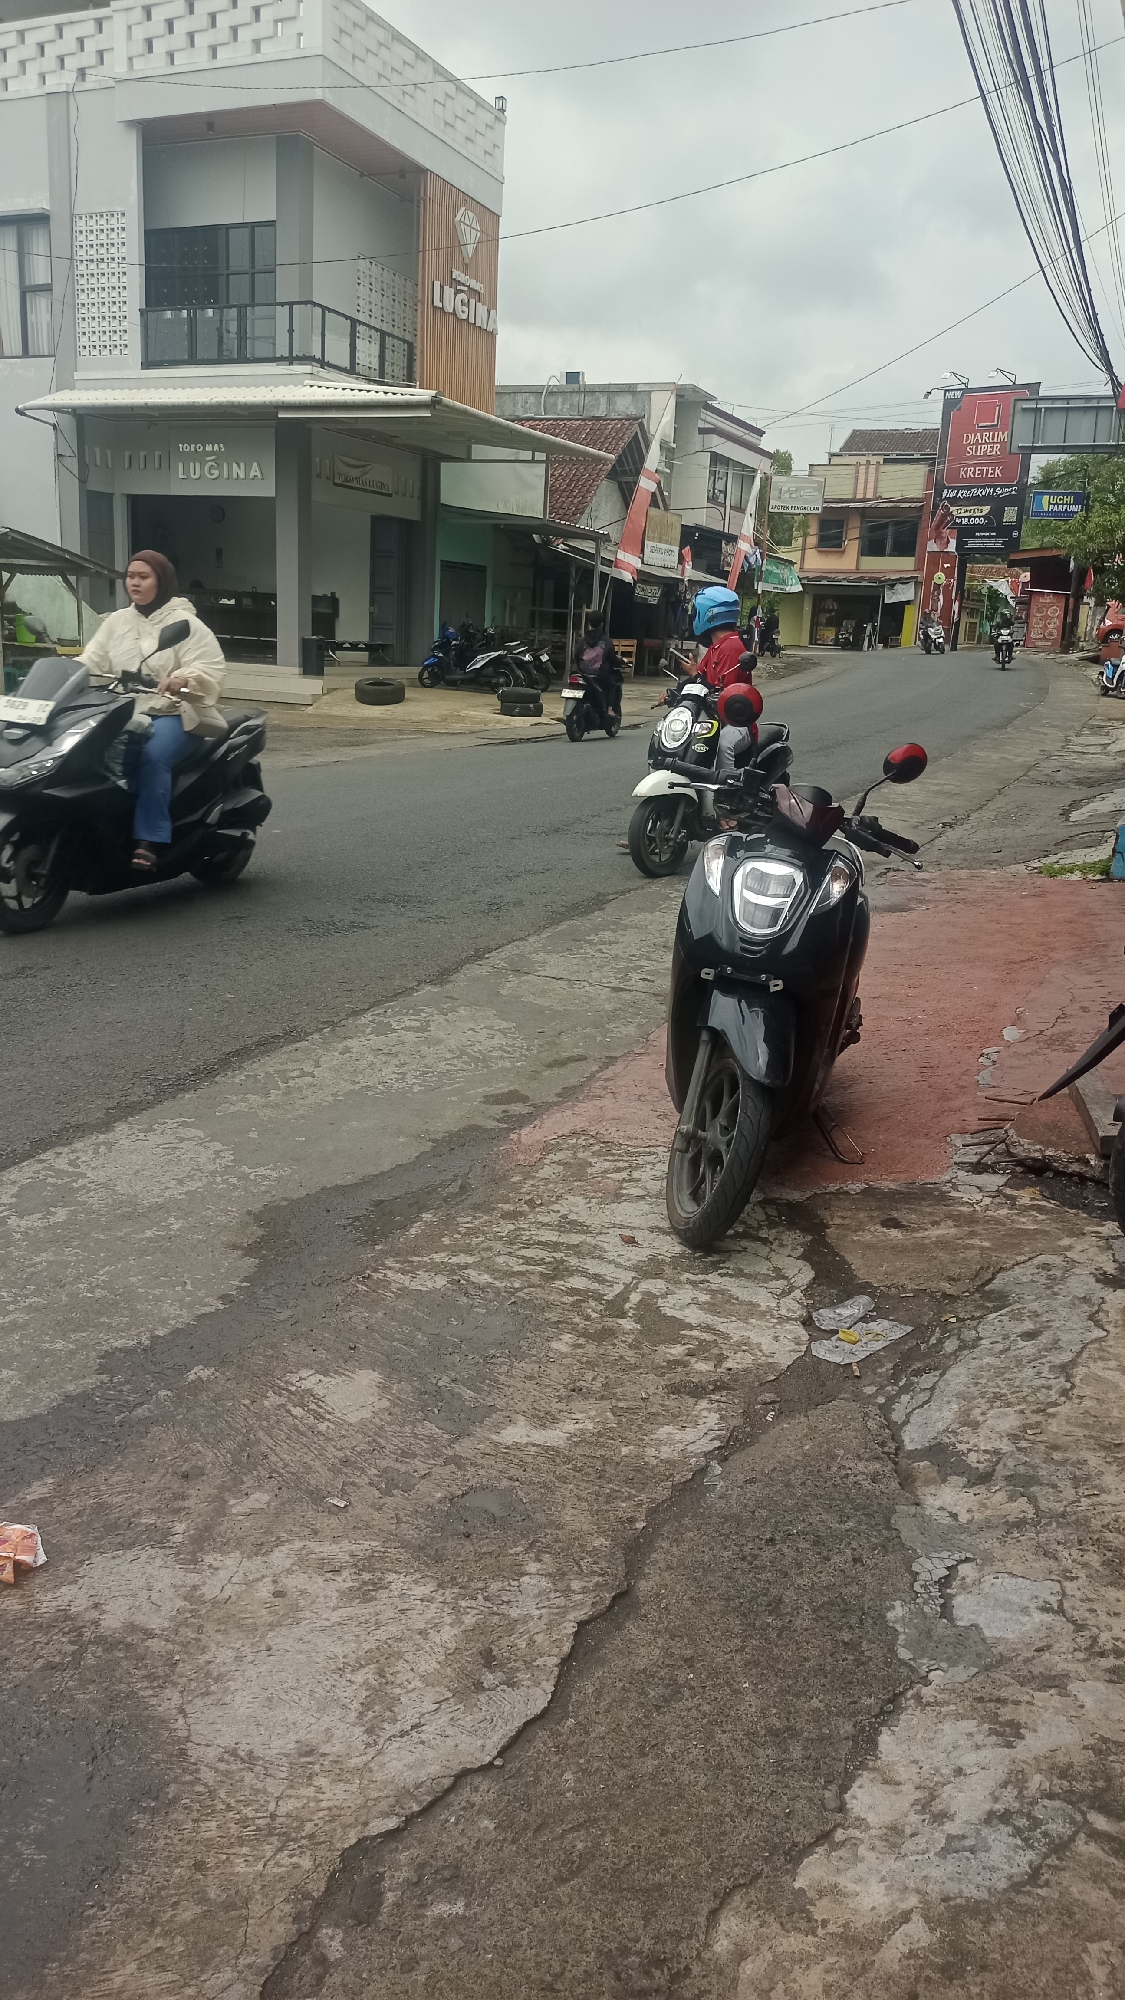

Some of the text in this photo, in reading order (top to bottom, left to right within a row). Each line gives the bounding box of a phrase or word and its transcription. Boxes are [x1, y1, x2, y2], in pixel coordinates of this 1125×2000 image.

[945, 391, 963, 399] NEW
[963, 432, 1008, 444] DJARUM
[178, 443, 225, 452] TOKO MAS
[966, 444, 1001, 456] SUPER
[959, 466, 1003, 478] KRETEK
[1049, 495, 1074, 504] UCHI
